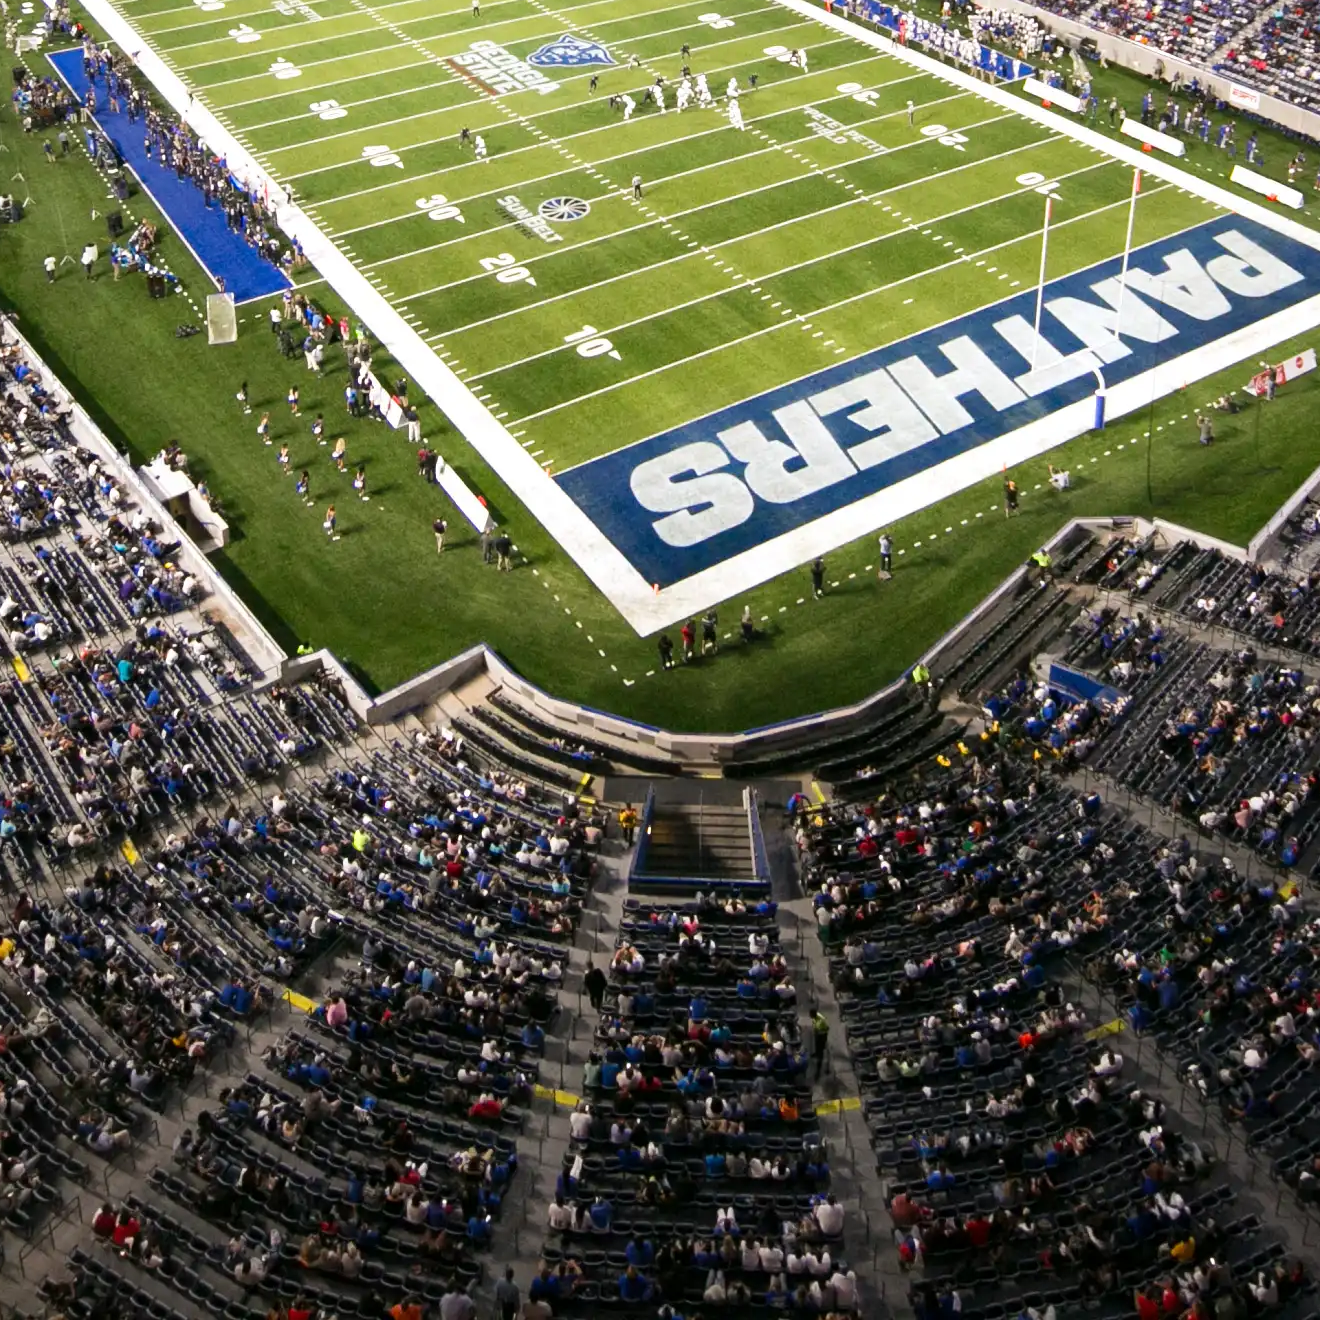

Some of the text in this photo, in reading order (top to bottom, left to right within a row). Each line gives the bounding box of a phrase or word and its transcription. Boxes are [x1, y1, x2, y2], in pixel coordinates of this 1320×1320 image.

[451, 53, 525, 95] STATE
[468, 40, 561, 95] GEORGIA
[309, 99, 348, 120] 50
[920, 124, 969, 146] 20
[1015, 171, 1061, 195] 10
[415, 194, 461, 221] 30
[479, 253, 530, 283] 20
[563, 324, 614, 358] 10
[629, 229, 1305, 548] PANTHERS
